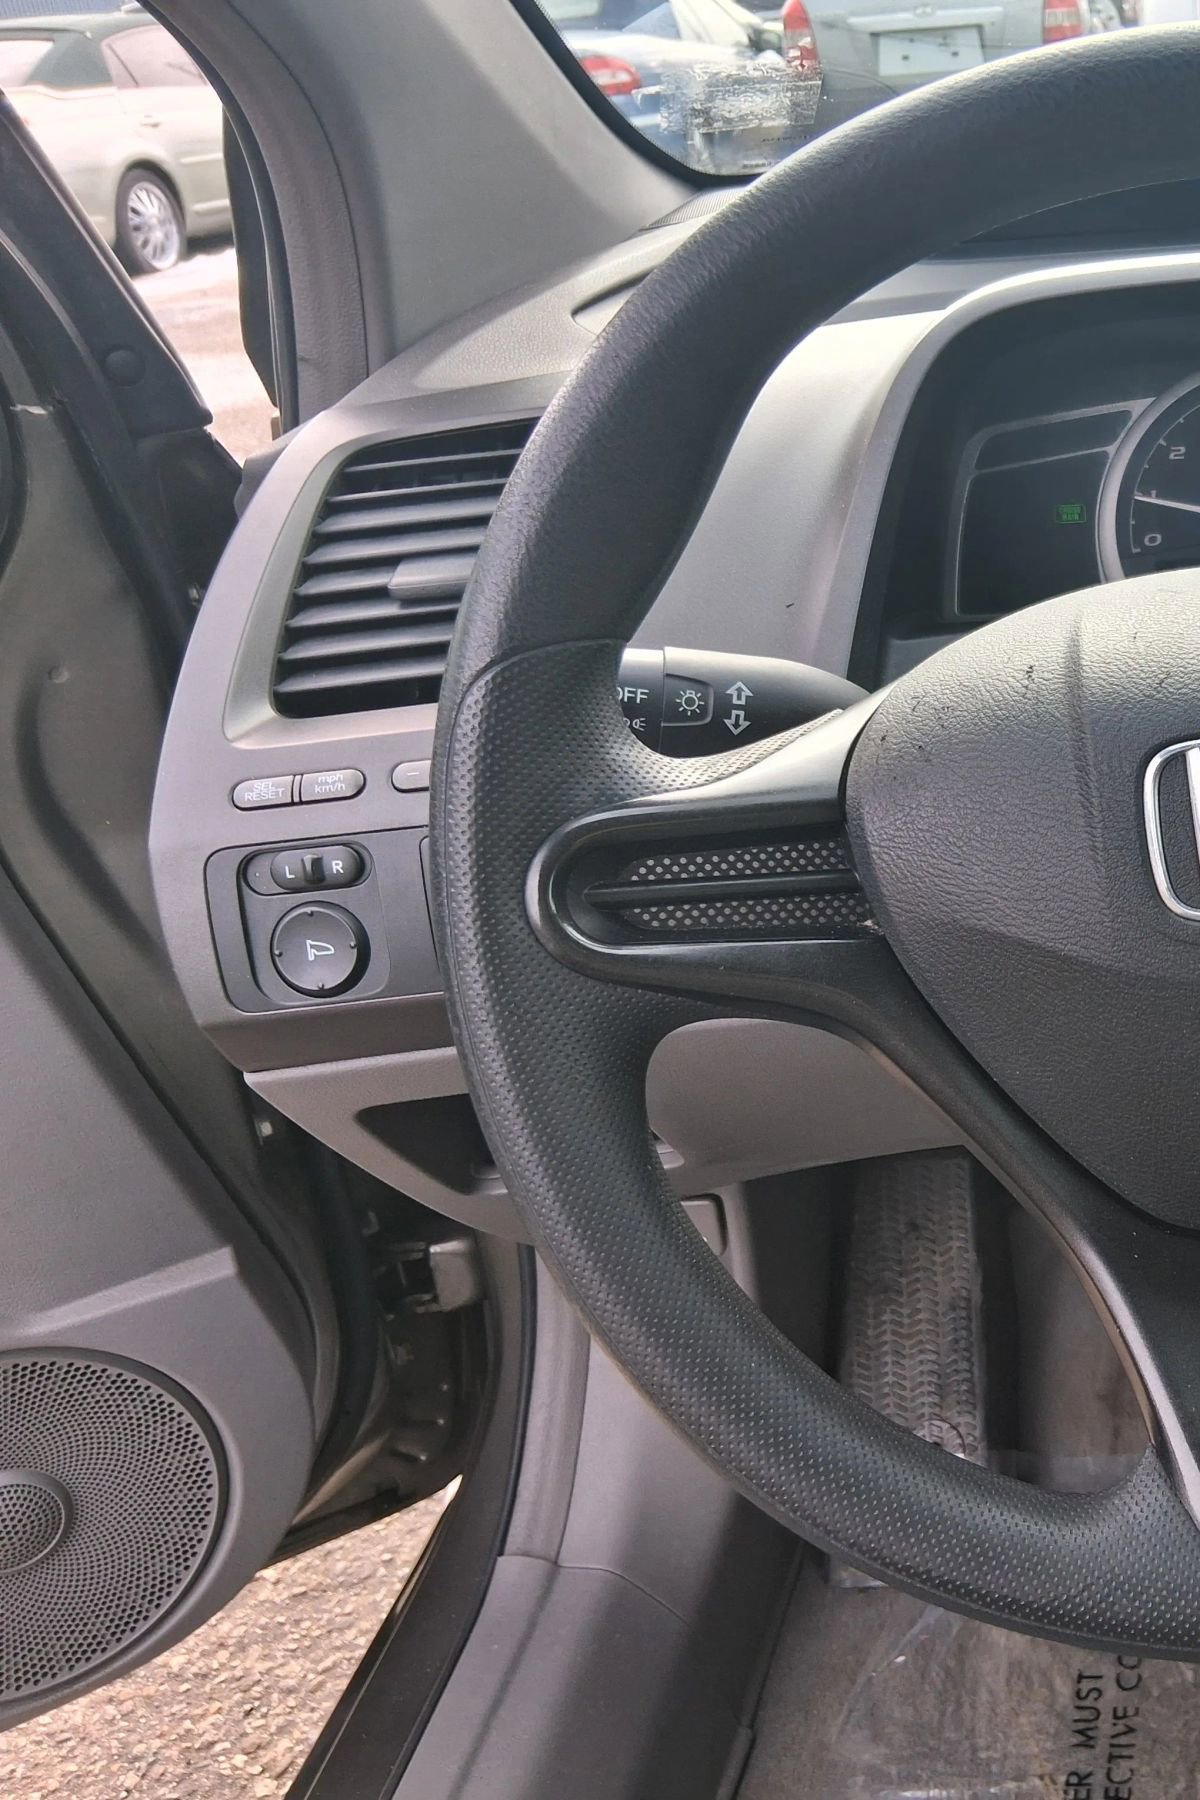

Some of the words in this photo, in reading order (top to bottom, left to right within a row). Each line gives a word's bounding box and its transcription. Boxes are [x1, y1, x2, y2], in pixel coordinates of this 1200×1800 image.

[1169, 446, 1186, 460] 2
[1144, 533, 1162, 546] 0
[318, 773, 344, 785] mph
[253, 781, 275, 793] SEL
[315, 782, 346, 794] km/h
[244, 787, 285, 801] RESET
[285, 865, 295, 878] L
[332, 860, 344, 874] R
[1071, 1672, 1104, 1749] MUST
